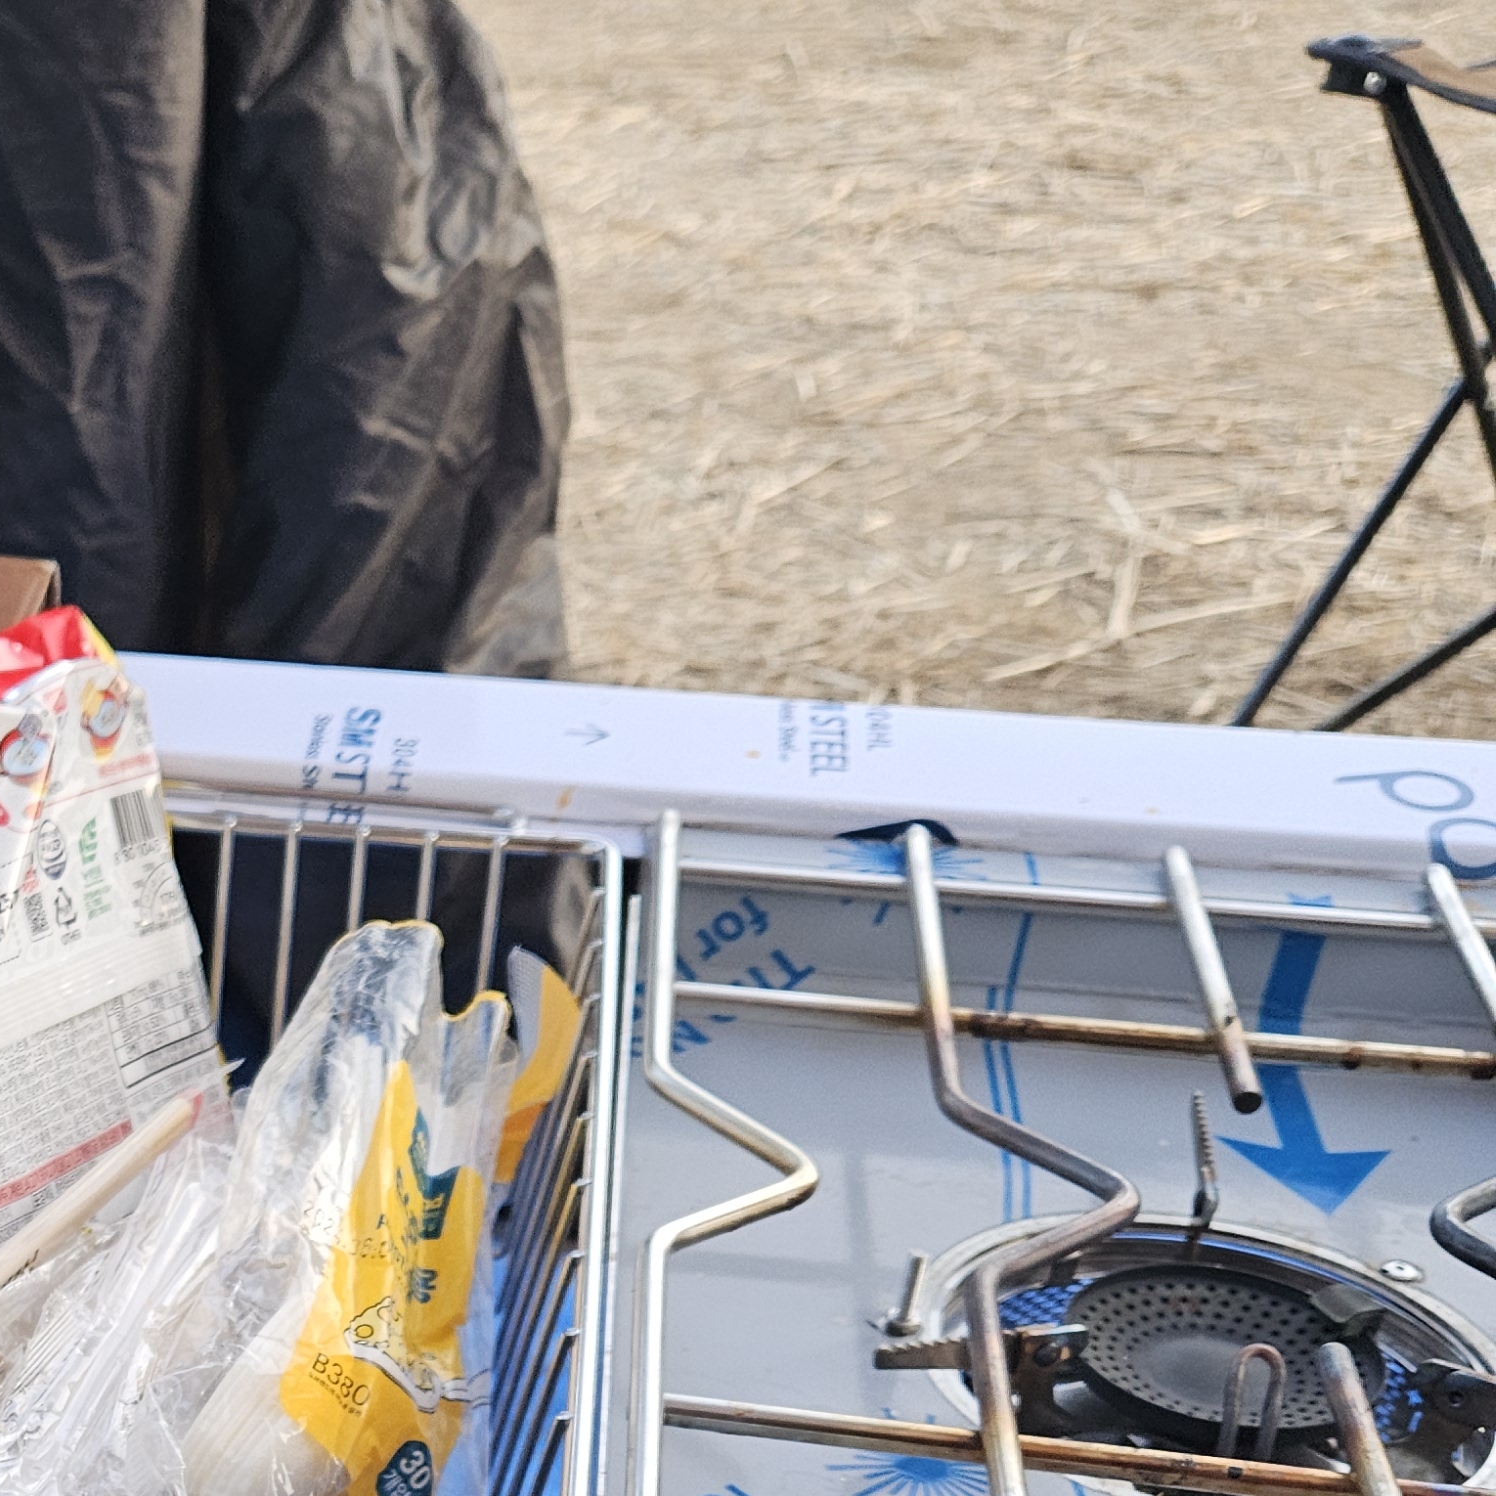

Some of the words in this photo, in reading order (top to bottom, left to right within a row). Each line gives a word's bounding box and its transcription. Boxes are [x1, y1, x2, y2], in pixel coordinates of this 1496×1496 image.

[695, 896, 771, 961] for
[311, 1352, 371, 1407] B380
[399, 1450, 432, 1490] 30
